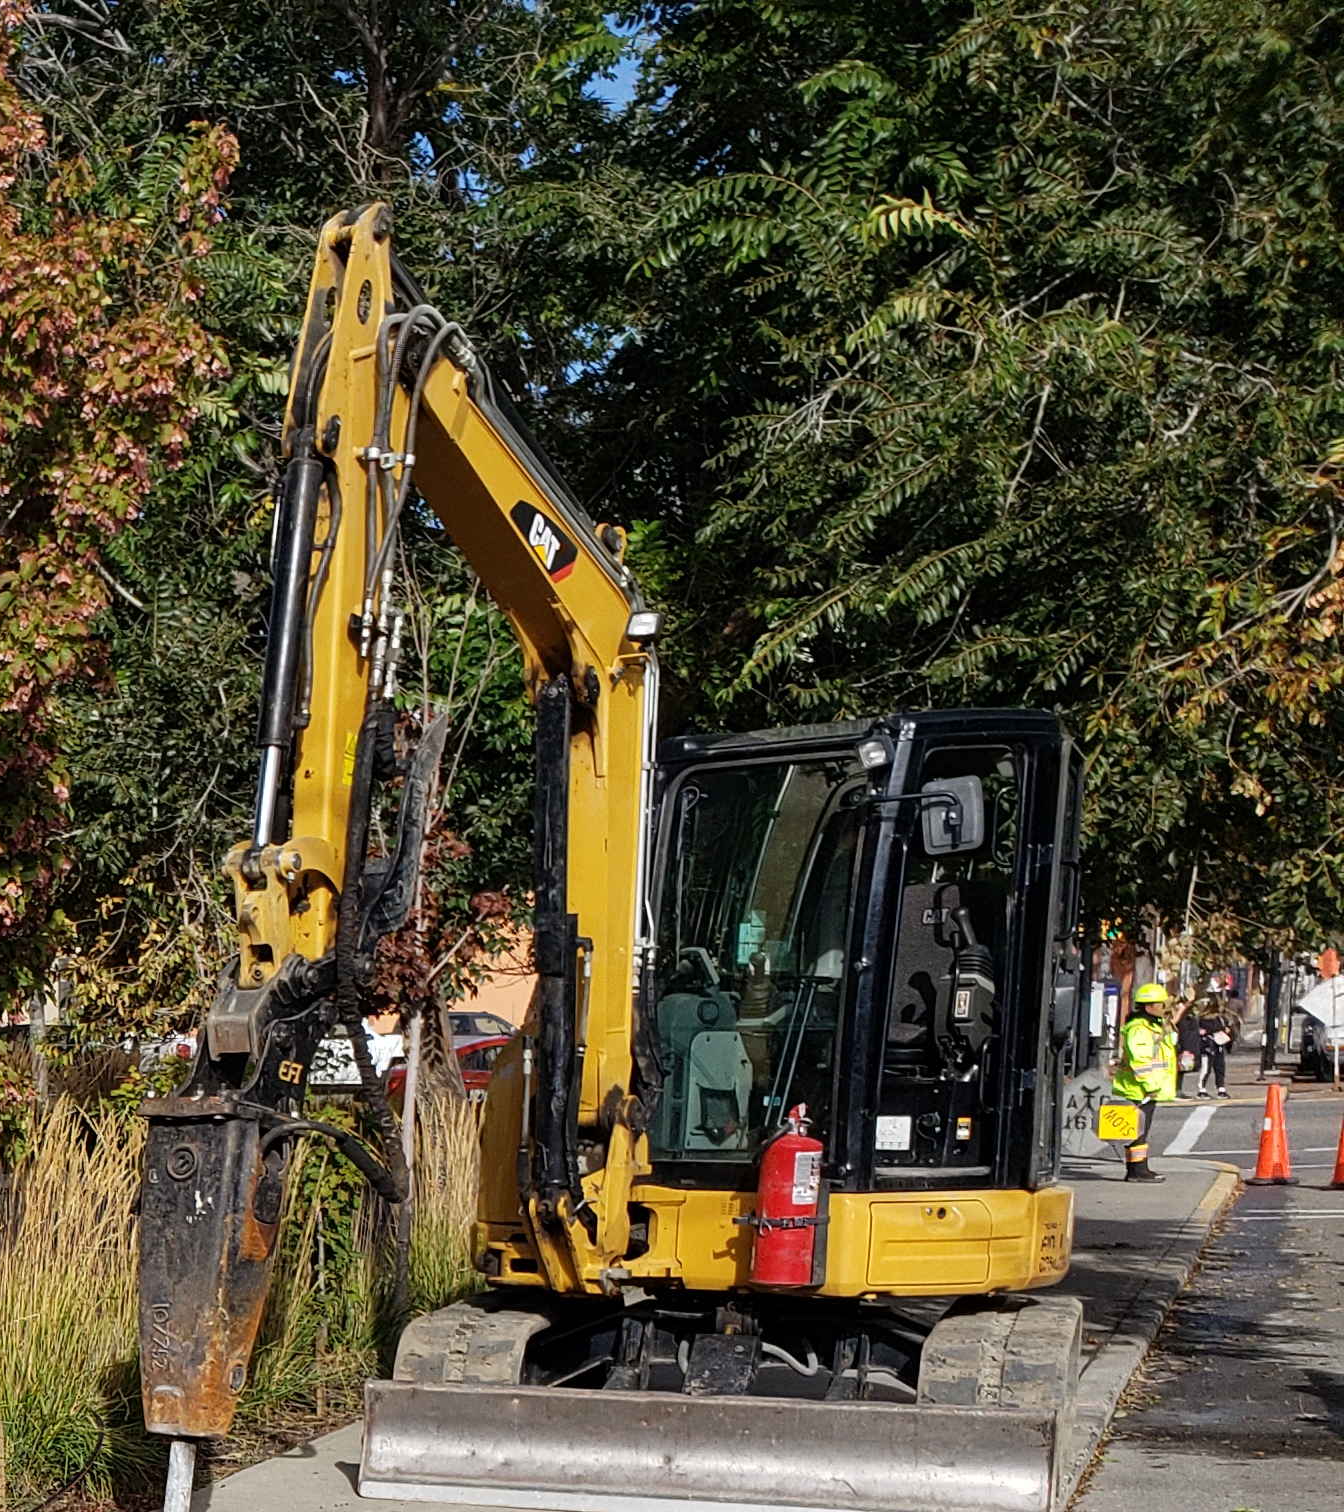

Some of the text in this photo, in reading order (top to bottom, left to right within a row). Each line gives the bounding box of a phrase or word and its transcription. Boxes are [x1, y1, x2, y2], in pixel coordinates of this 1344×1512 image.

[529, 513, 561, 570] CAT
[922, 908, 950, 924] CAT
[1102, 1109, 1135, 1137] SLOW
